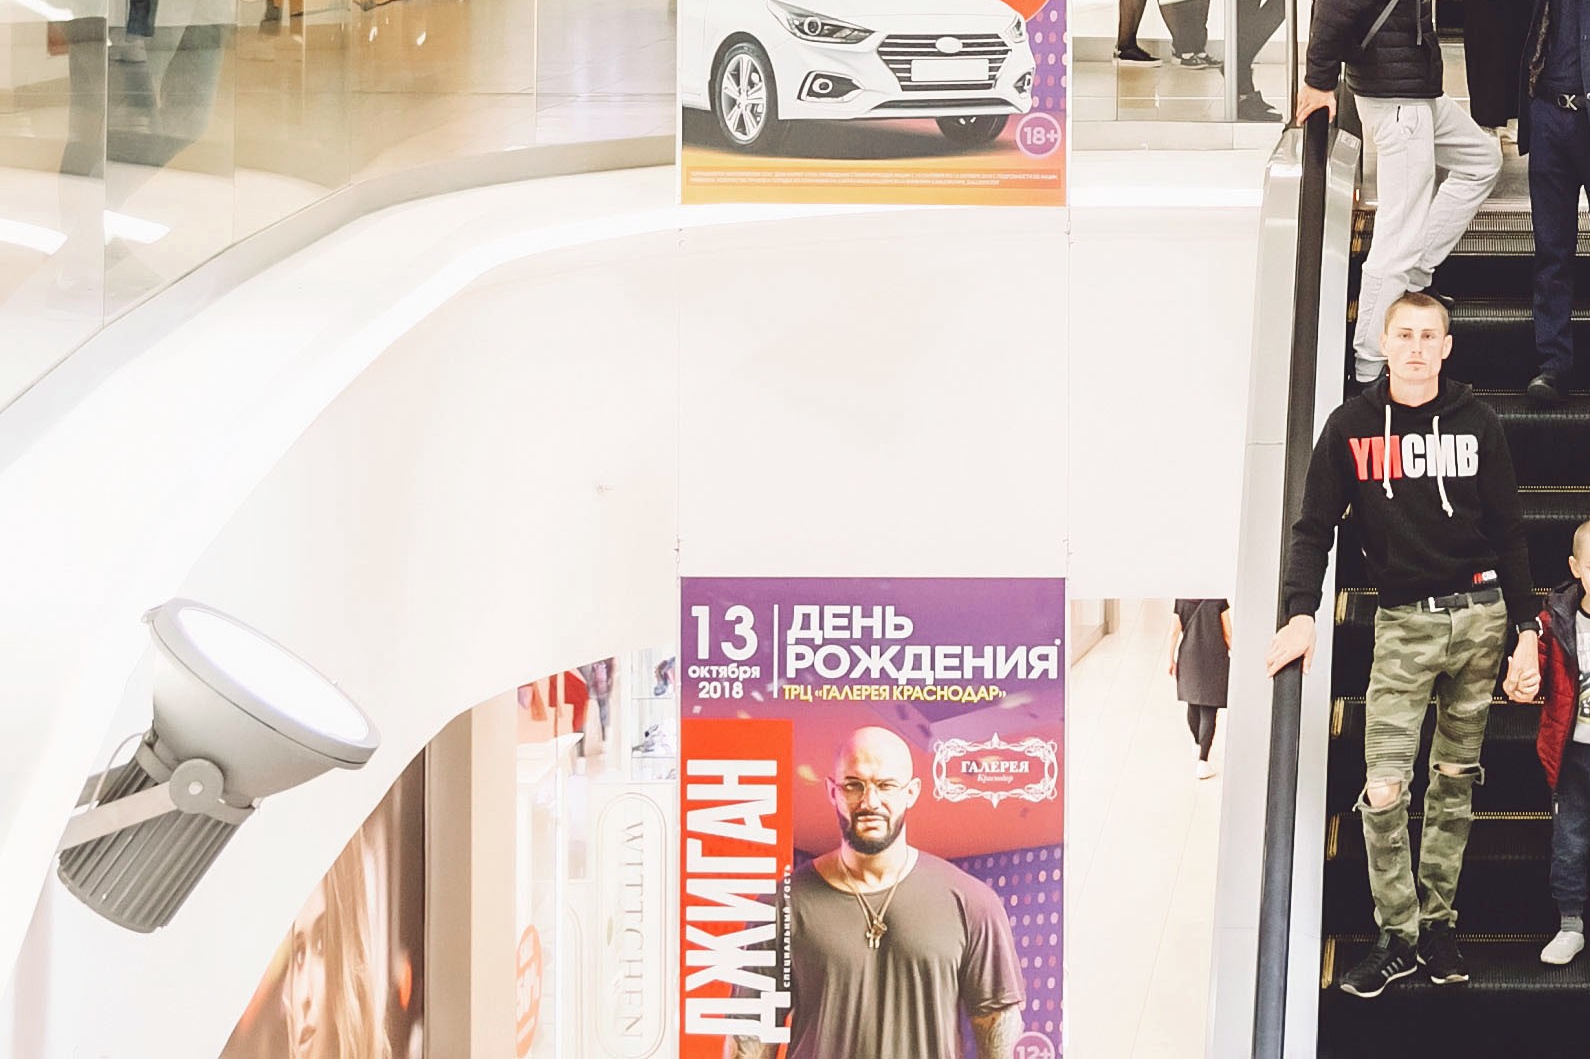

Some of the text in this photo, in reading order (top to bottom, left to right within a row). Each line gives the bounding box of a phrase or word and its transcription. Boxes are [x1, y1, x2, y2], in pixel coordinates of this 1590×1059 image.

[1024, 126, 1059, 145] 18+
[1348, 433, 1479, 481] YMCMB
[691, 605, 758, 661] 13
[786, 604, 914, 644] ДЕНЬ
[688, 662, 760, 680] октября
[786, 643, 1058, 684] РОЖДЕНИЯ
[698, 681, 744, 699] 2018
[783, 684, 1007, 703] ТРЦ «ГАЛЕРЕЯ КРАСНОДАР»
[961, 760, 1030, 773] ГАЛЕРЕЯ
[783, 864, 792, 899] ГОСТЬ
[685, 759, 791, 1044] ДЖИГАН
[622, 821, 644, 1038] WITTCHEN
[1016, 1044, 1051, 1059] 12+
